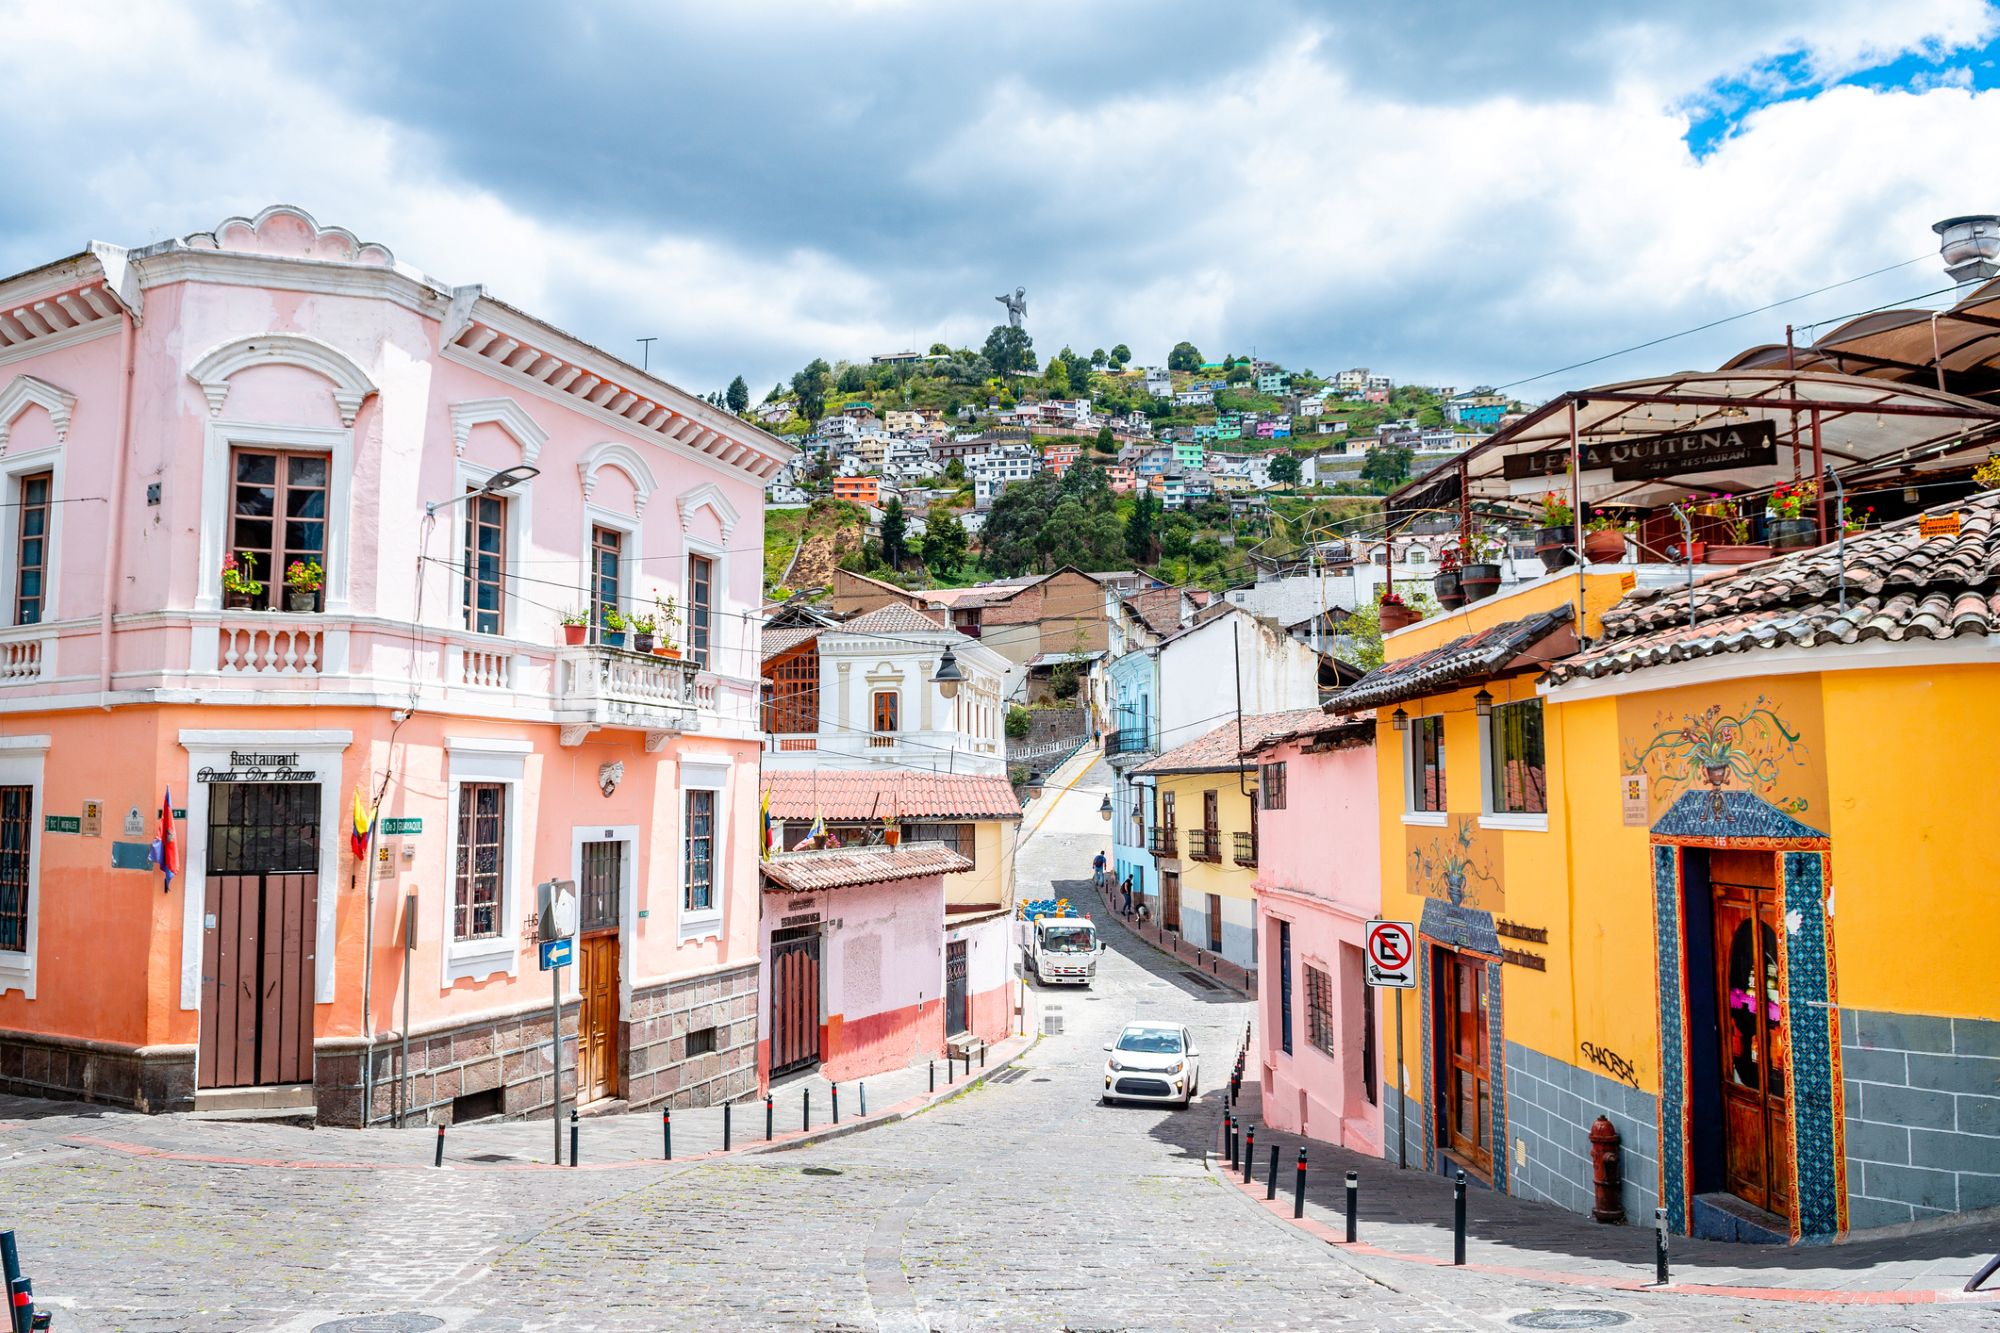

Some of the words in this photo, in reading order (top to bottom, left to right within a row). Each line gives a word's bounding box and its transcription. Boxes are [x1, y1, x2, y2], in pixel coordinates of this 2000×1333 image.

[1529, 450, 1602, 471] LEA
[1681, 449, 1750, 467] RESTAURANT
[230, 751, 299, 766] Restaurant
[245, 766, 268, 781] De
[398, 822, 421, 832] GUAYAQUIL
[1380, 932, 1400, 960] E
